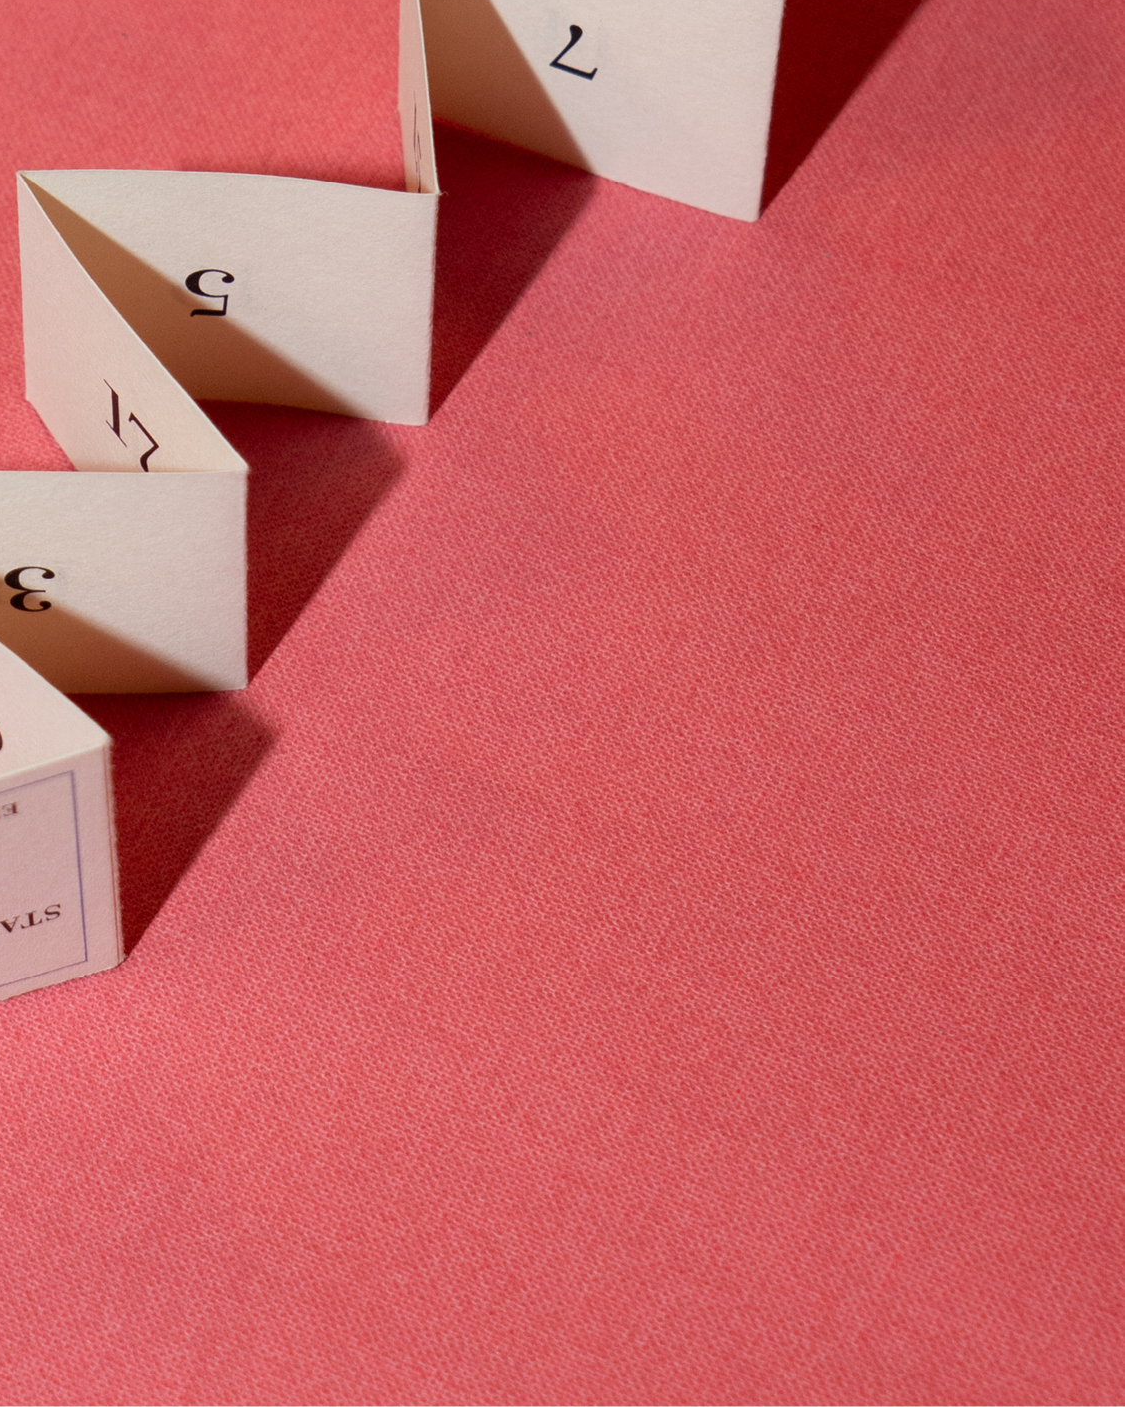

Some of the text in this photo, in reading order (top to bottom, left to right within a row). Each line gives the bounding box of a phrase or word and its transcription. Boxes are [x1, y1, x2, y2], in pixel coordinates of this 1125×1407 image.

[549, 24, 598, 82] 7
[184, 269, 236, 318] 5
[4, 566, 55, 612] 3
